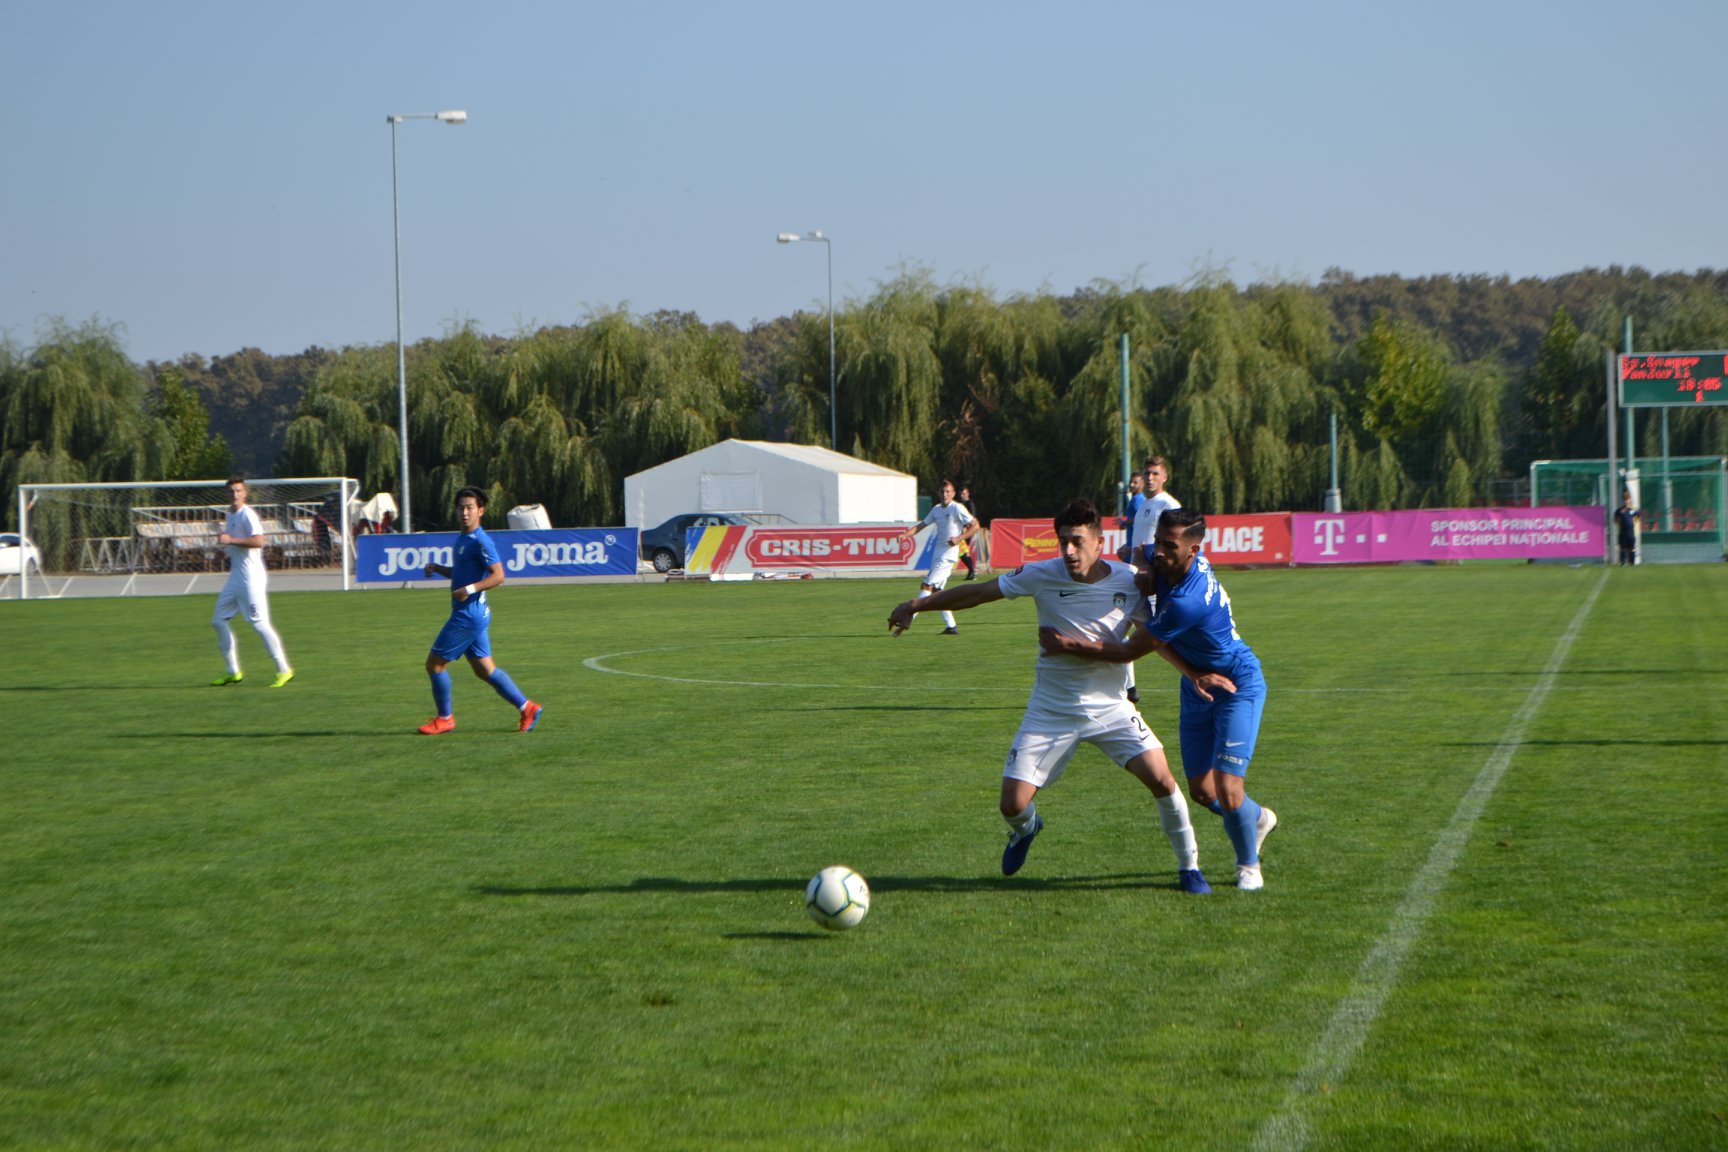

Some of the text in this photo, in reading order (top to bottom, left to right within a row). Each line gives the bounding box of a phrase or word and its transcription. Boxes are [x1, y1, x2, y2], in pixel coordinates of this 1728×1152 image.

[1430, 517, 1574, 532] SPONSOR PRINCIPAL
[760, 538, 900, 556] CRIS-TIM
[1201, 526, 1264, 553] PLACE
[1430, 535, 1449, 547] AL
[1452, 533, 1506, 546] ECHIPEI
[378, 546, 454, 576] Jom
[1131, 716, 1147, 732] 2
